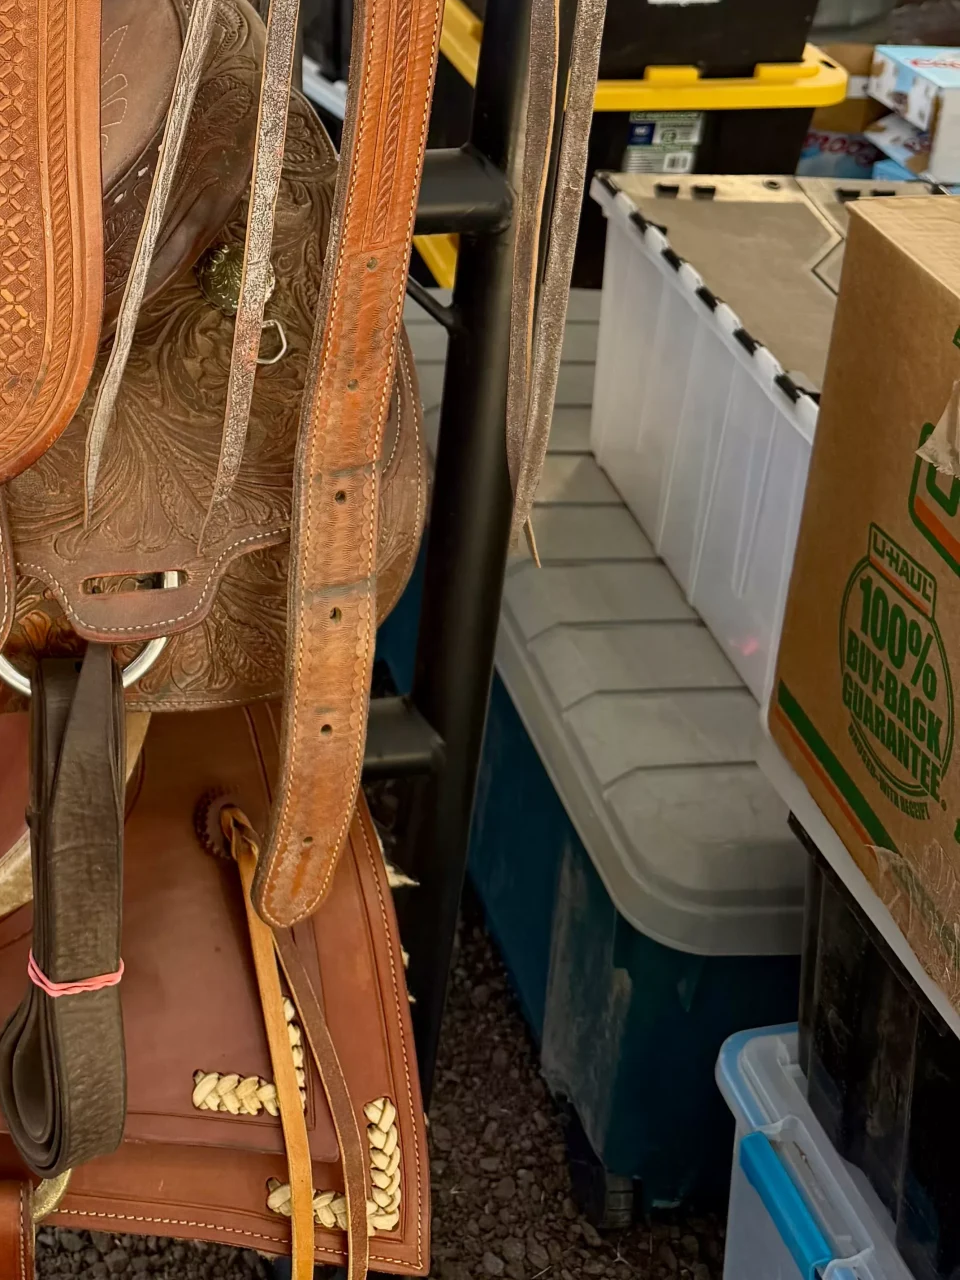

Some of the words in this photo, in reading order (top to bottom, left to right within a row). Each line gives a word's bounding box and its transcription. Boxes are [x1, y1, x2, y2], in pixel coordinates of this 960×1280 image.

[872, 531, 933, 603] U-HAUL
[846, 626, 943, 762] BUY-BACK
[859, 575, 938, 702] 100%
[841, 671, 942, 804] GUARANTEE
